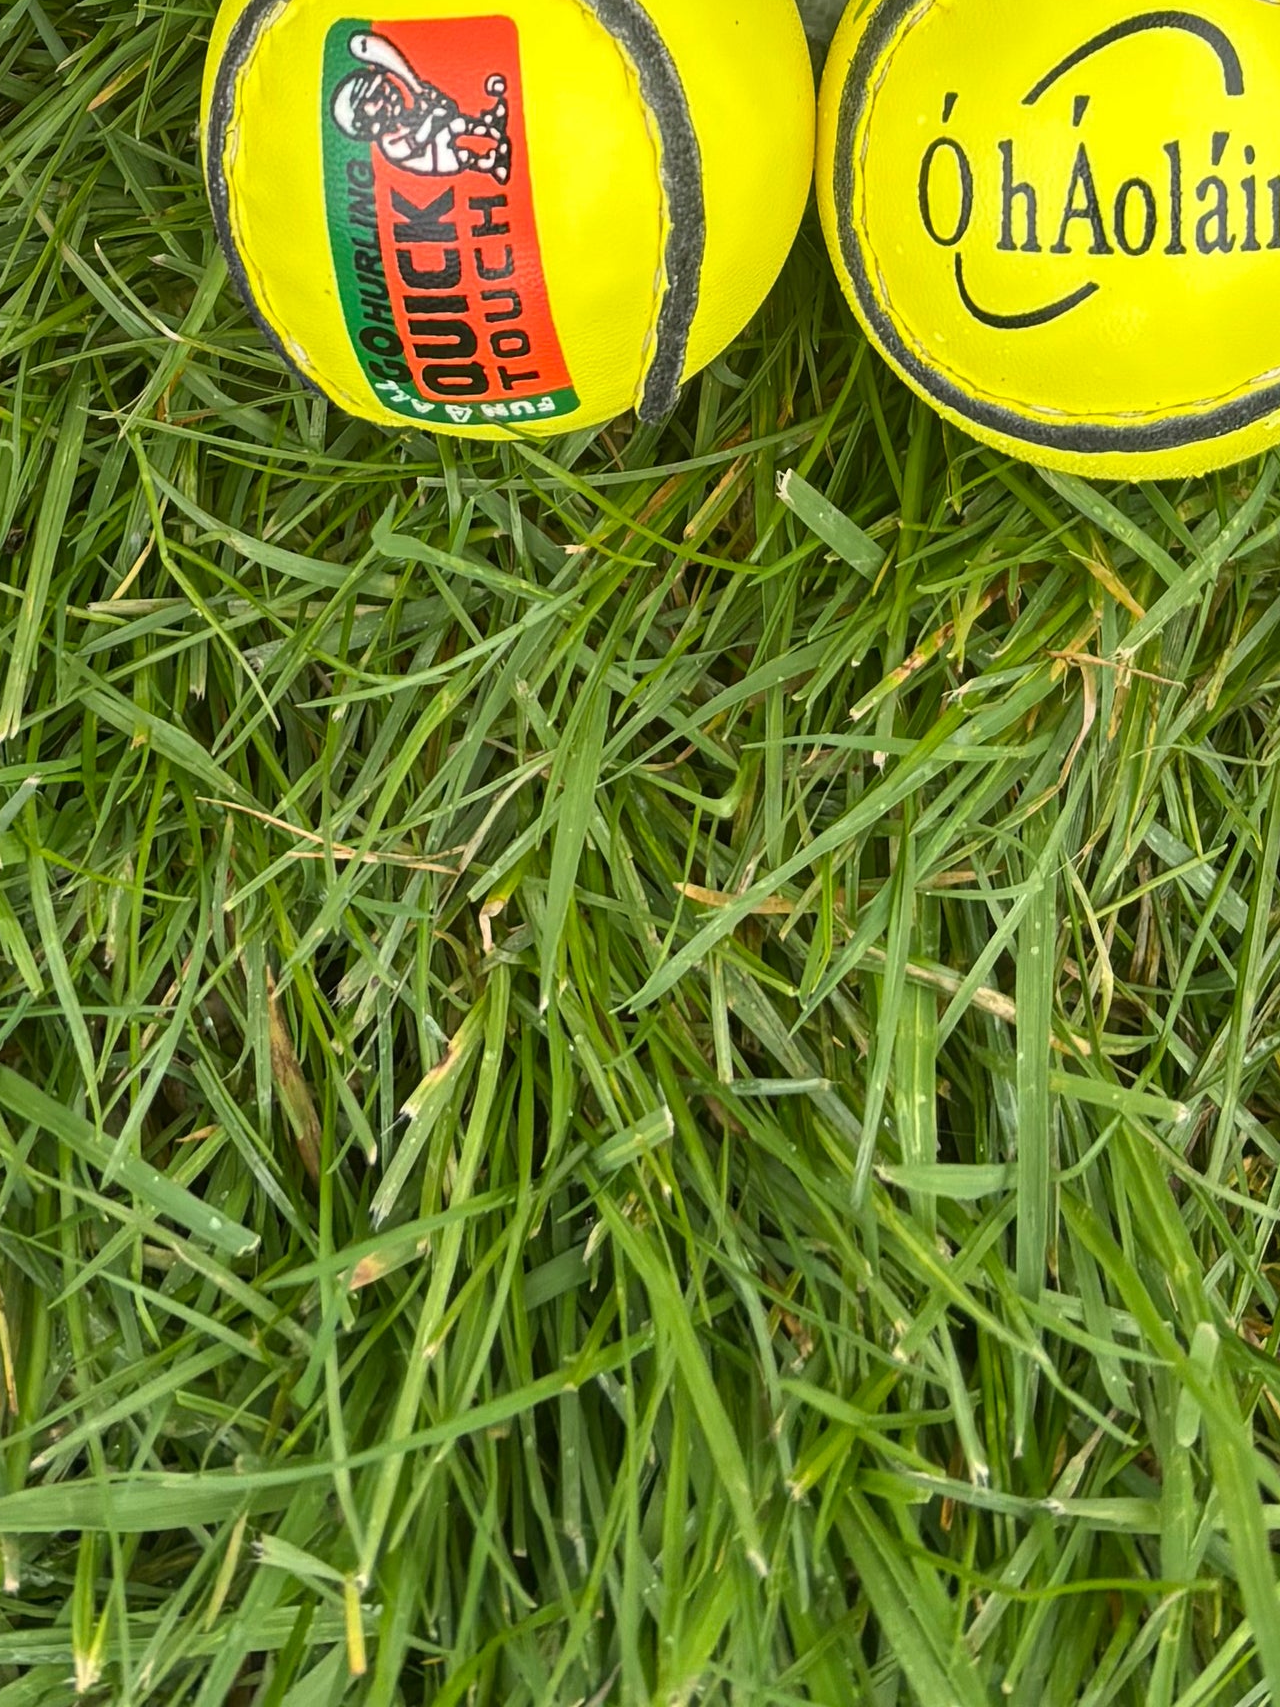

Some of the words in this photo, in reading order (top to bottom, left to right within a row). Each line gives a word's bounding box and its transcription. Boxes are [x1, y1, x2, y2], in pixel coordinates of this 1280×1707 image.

[918, 92, 974, 247] Ó
[390, 185, 490, 396] QUICK
[468, 194, 541, 391] TOUCH
[375, 379, 436, 414] ALL
[444, 403, 474, 424] 4
[480, 396, 556, 418] FUN
